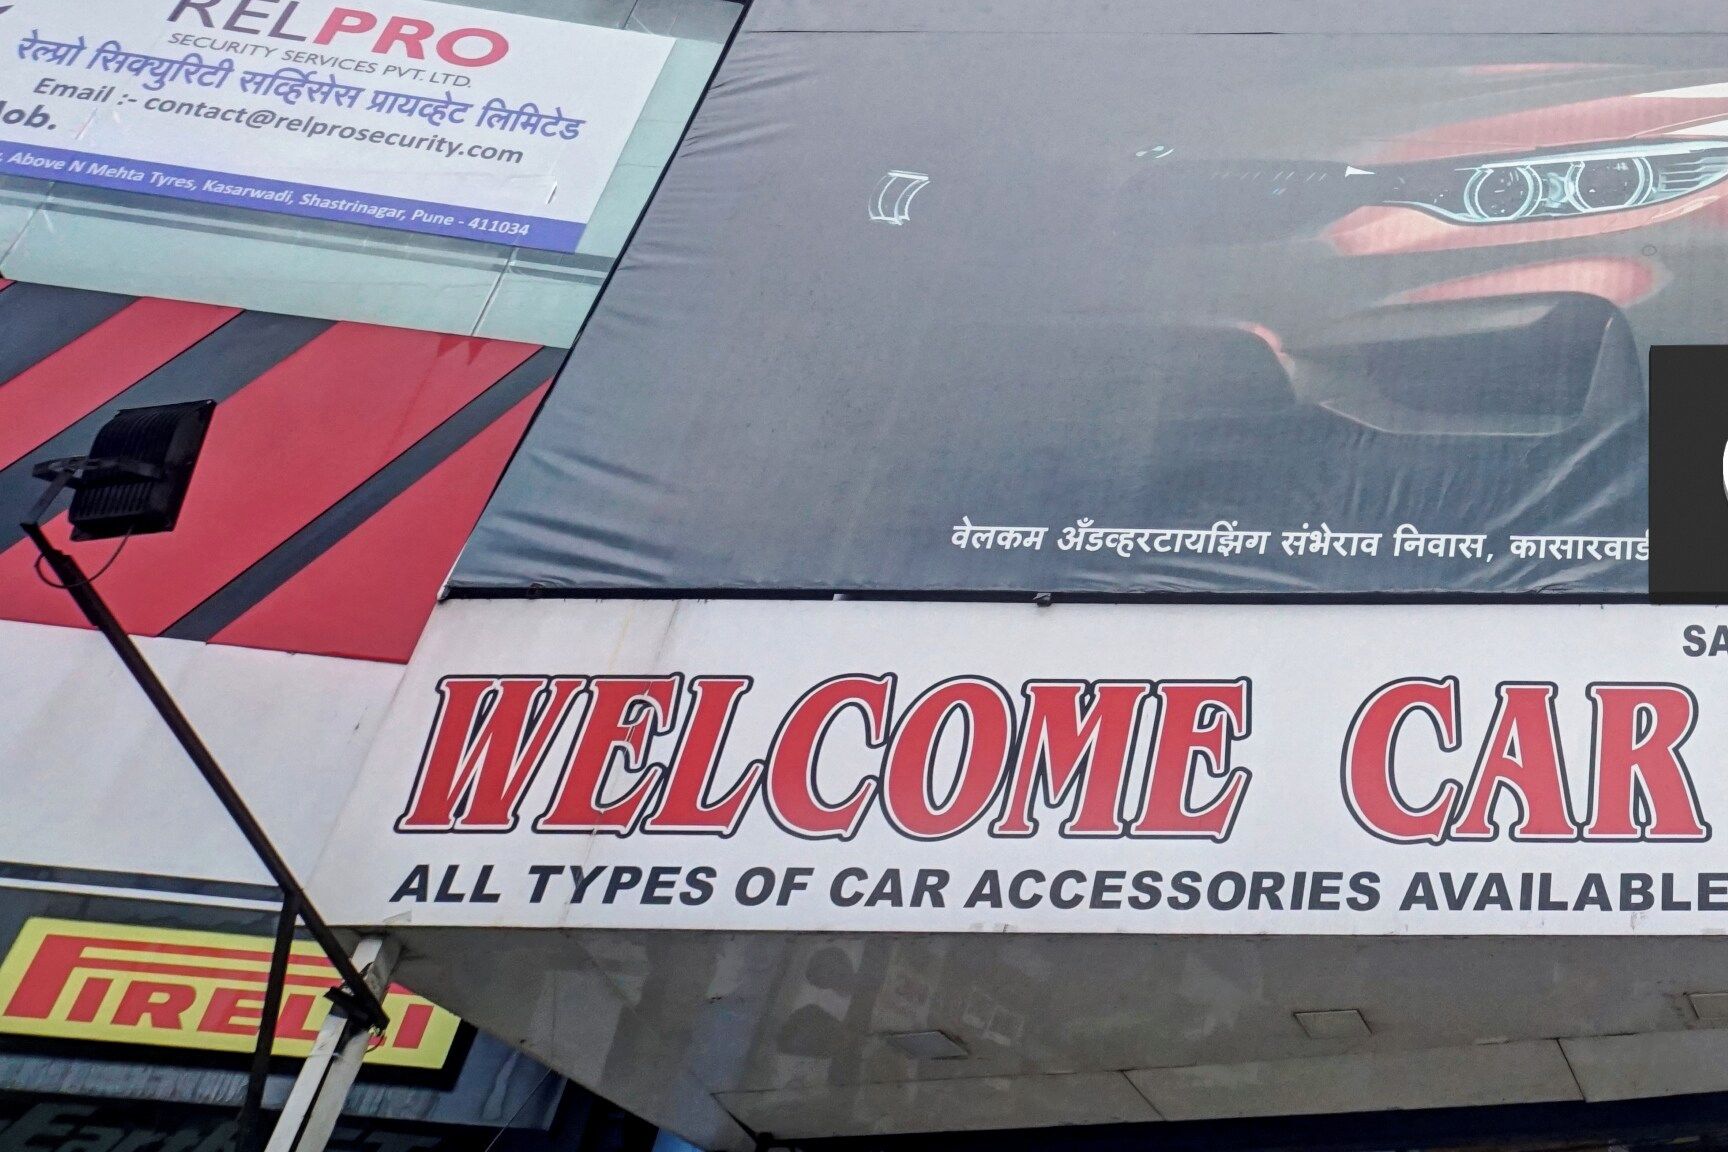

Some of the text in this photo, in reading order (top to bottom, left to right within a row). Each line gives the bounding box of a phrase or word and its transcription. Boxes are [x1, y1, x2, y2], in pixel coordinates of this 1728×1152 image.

[17, 29, 86, 67] रेल्प्रो
[475, 97, 586, 140] लिमिटेड
[168, 32, 471, 88] SECURITY SERVICES PVT. LTD.
[33, 77, 115, 104] Email
[144, 97, 523, 164] contact@relprosecurity.com
[7, 152, 65, 170] Above
[68, 160, 87, 173] N
[86, 163, 145, 182] Mehta
[150, 172, 197, 191] Tyres,
[202, 179, 293, 206] Kasarwadi,
[299, 193, 406, 220] Shastrinagar,
[411, 209, 454, 226] Pune
[468, 217, 530, 236] 411034
[950, 516, 1049, 551] वेलकम
[1281, 523, 1382, 558] संभेराव
[1393, 523, 1494, 563] निवास,
[1510, 529, 1649, 560] कासारवाड
[396, 671, 1252, 844] WELCOME
[1341, 674, 1712, 845] CAR
[390, 864, 502, 904] ALL
[528, 864, 715, 908] TYPES
[733, 866, 815, 909] OF
[829, 867, 950, 911] CAR
[963, 868, 1382, 913] ACCESSORIES
[2, 934, 435, 1050] PIRELI
